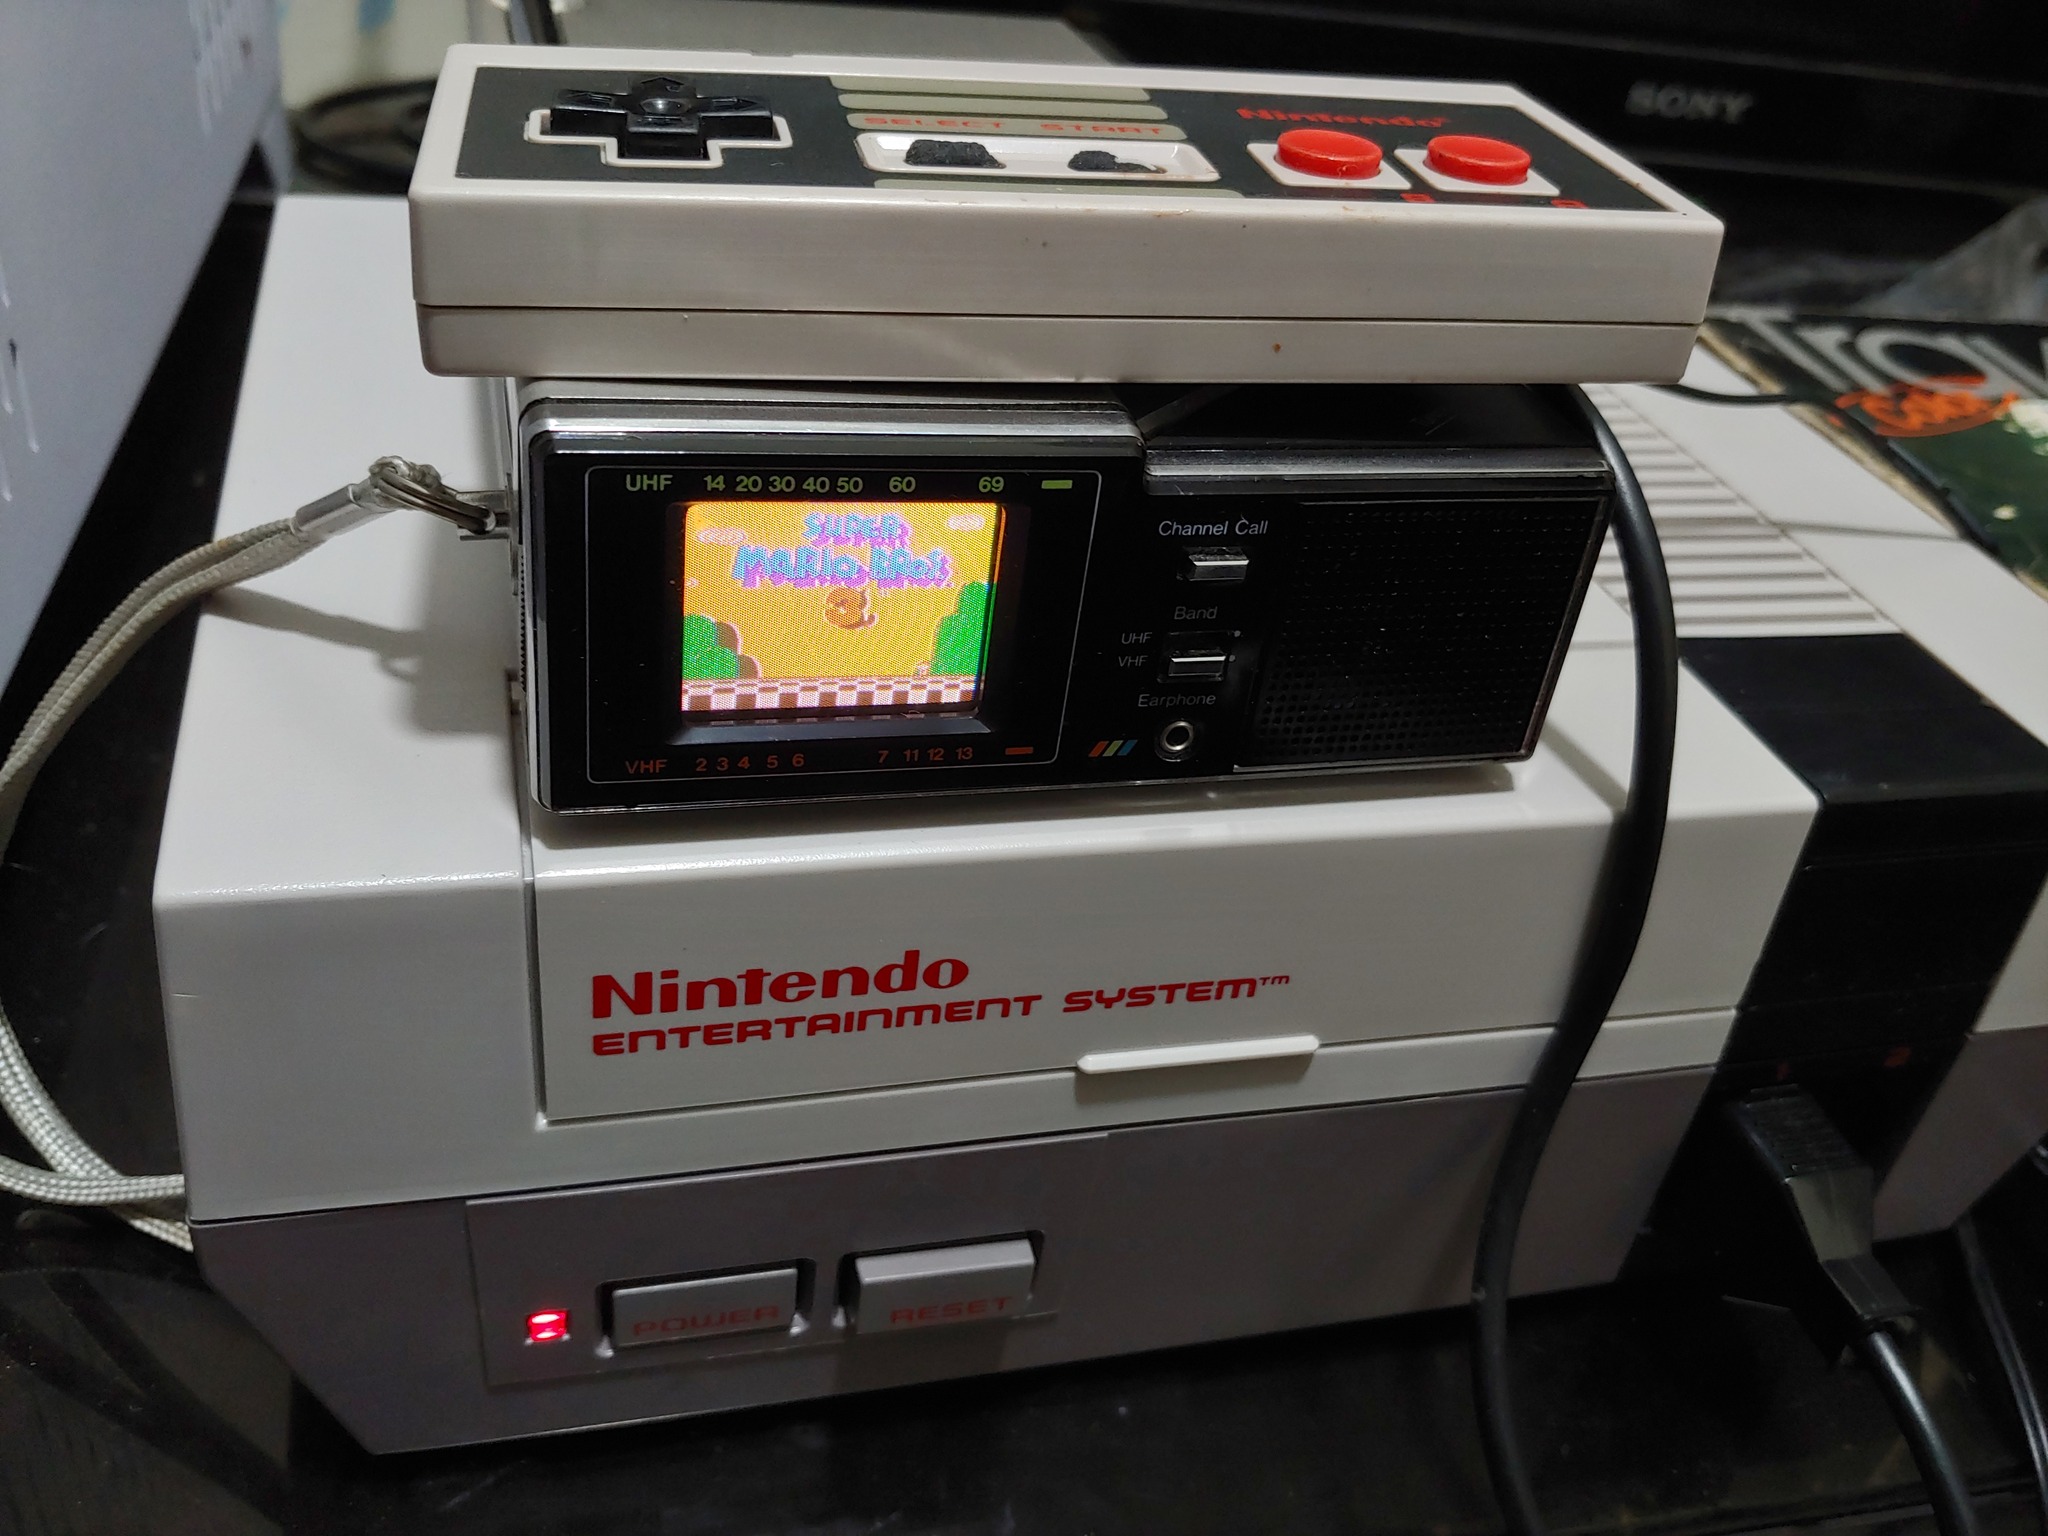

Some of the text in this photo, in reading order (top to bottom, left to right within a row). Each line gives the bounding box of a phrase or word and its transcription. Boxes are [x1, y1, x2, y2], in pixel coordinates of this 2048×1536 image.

[1624, 80, 1753, 124] SONY
[864, 116, 1005, 129] SELECT
[1040, 122, 1162, 136] START
[625, 473, 1005, 494] UHF 14 20 30 40 50 60 69
[802, 511, 912, 547] SUPER
[1158, 519, 1269, 536] Channel Call
[731, 545, 868, 588] MARIO
[824, 586, 878, 630] 3
[1173, 606, 1218, 620] Band
[1121, 631, 1153, 645] UHF
[1118, 655, 1149, 668] VHF
[1137, 693, 1217, 708] Earphone
[625, 746, 974, 774] VHF 2 3 4 5 6 7 11 12 13
[592, 949, 970, 1018] Nintendo
[592, 995, 1042, 1056] ENTERTAINMENT
[632, 1305, 780, 1338] POWER
[889, 1297, 1014, 1325] RESET
